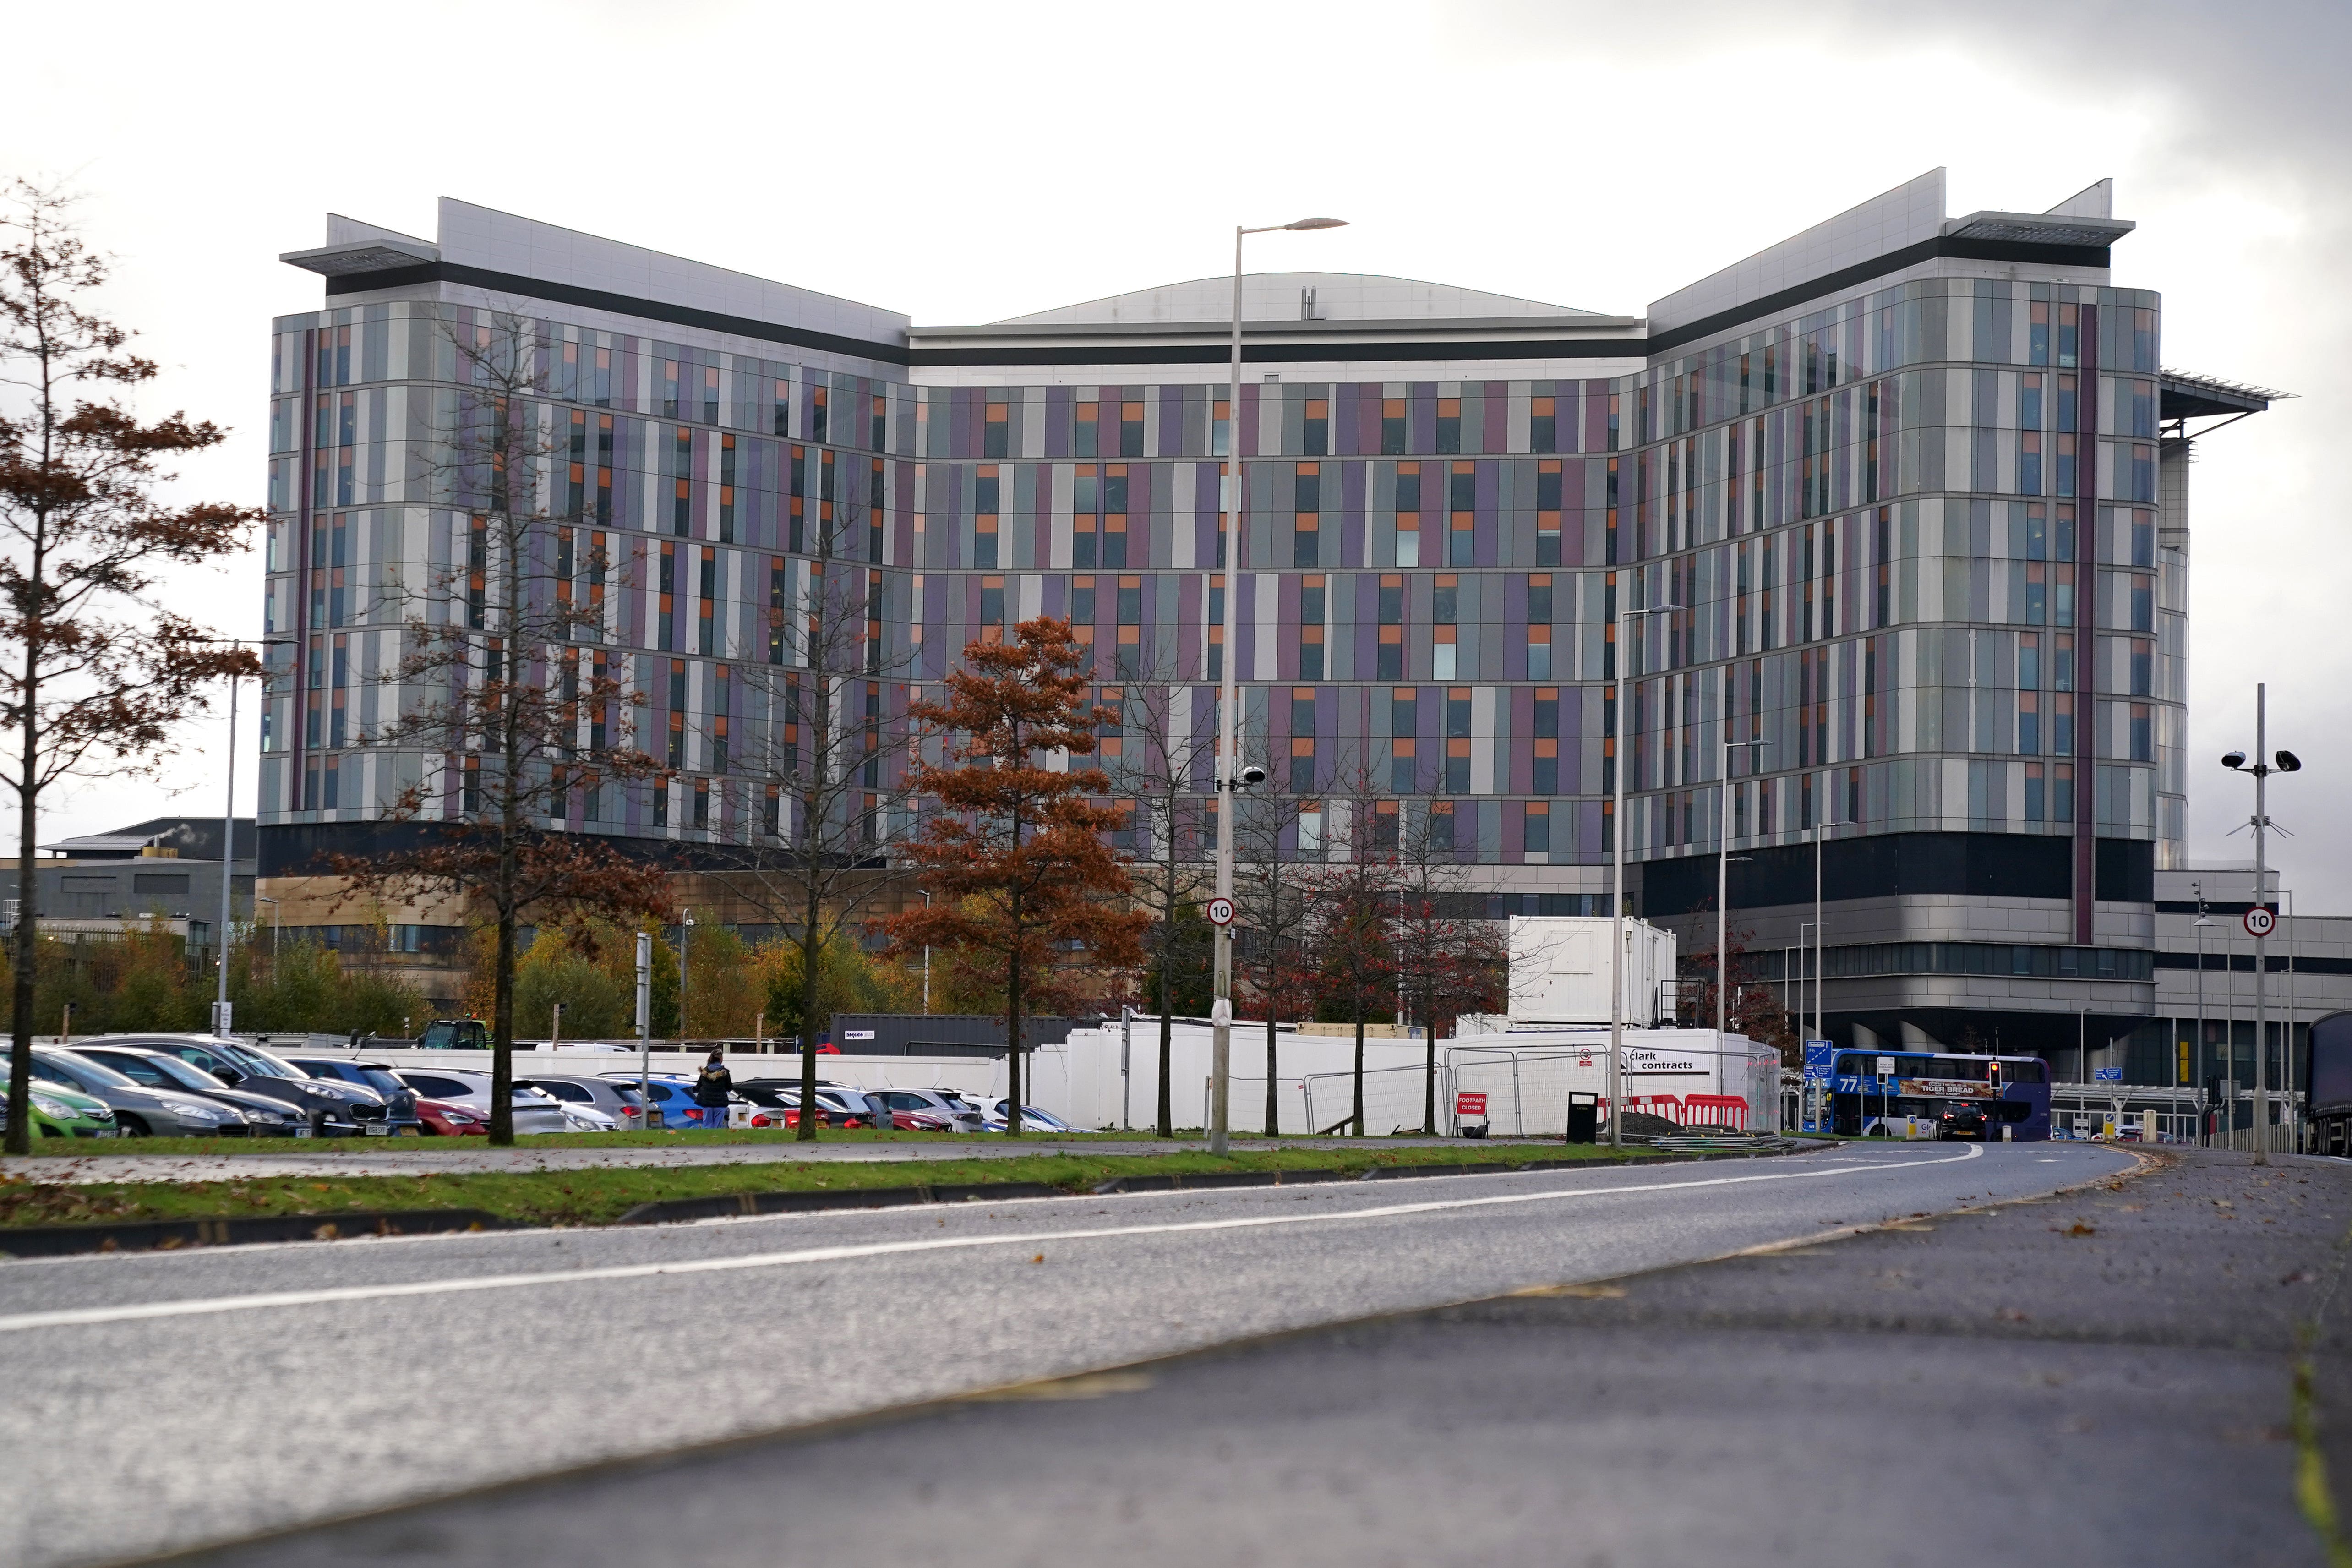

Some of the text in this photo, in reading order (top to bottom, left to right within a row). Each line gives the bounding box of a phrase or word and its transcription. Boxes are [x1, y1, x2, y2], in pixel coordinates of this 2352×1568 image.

[1214, 906, 1229, 918] 10
[2251, 915, 2269, 928] 10
[1840, 1078, 1857, 1092] 77
